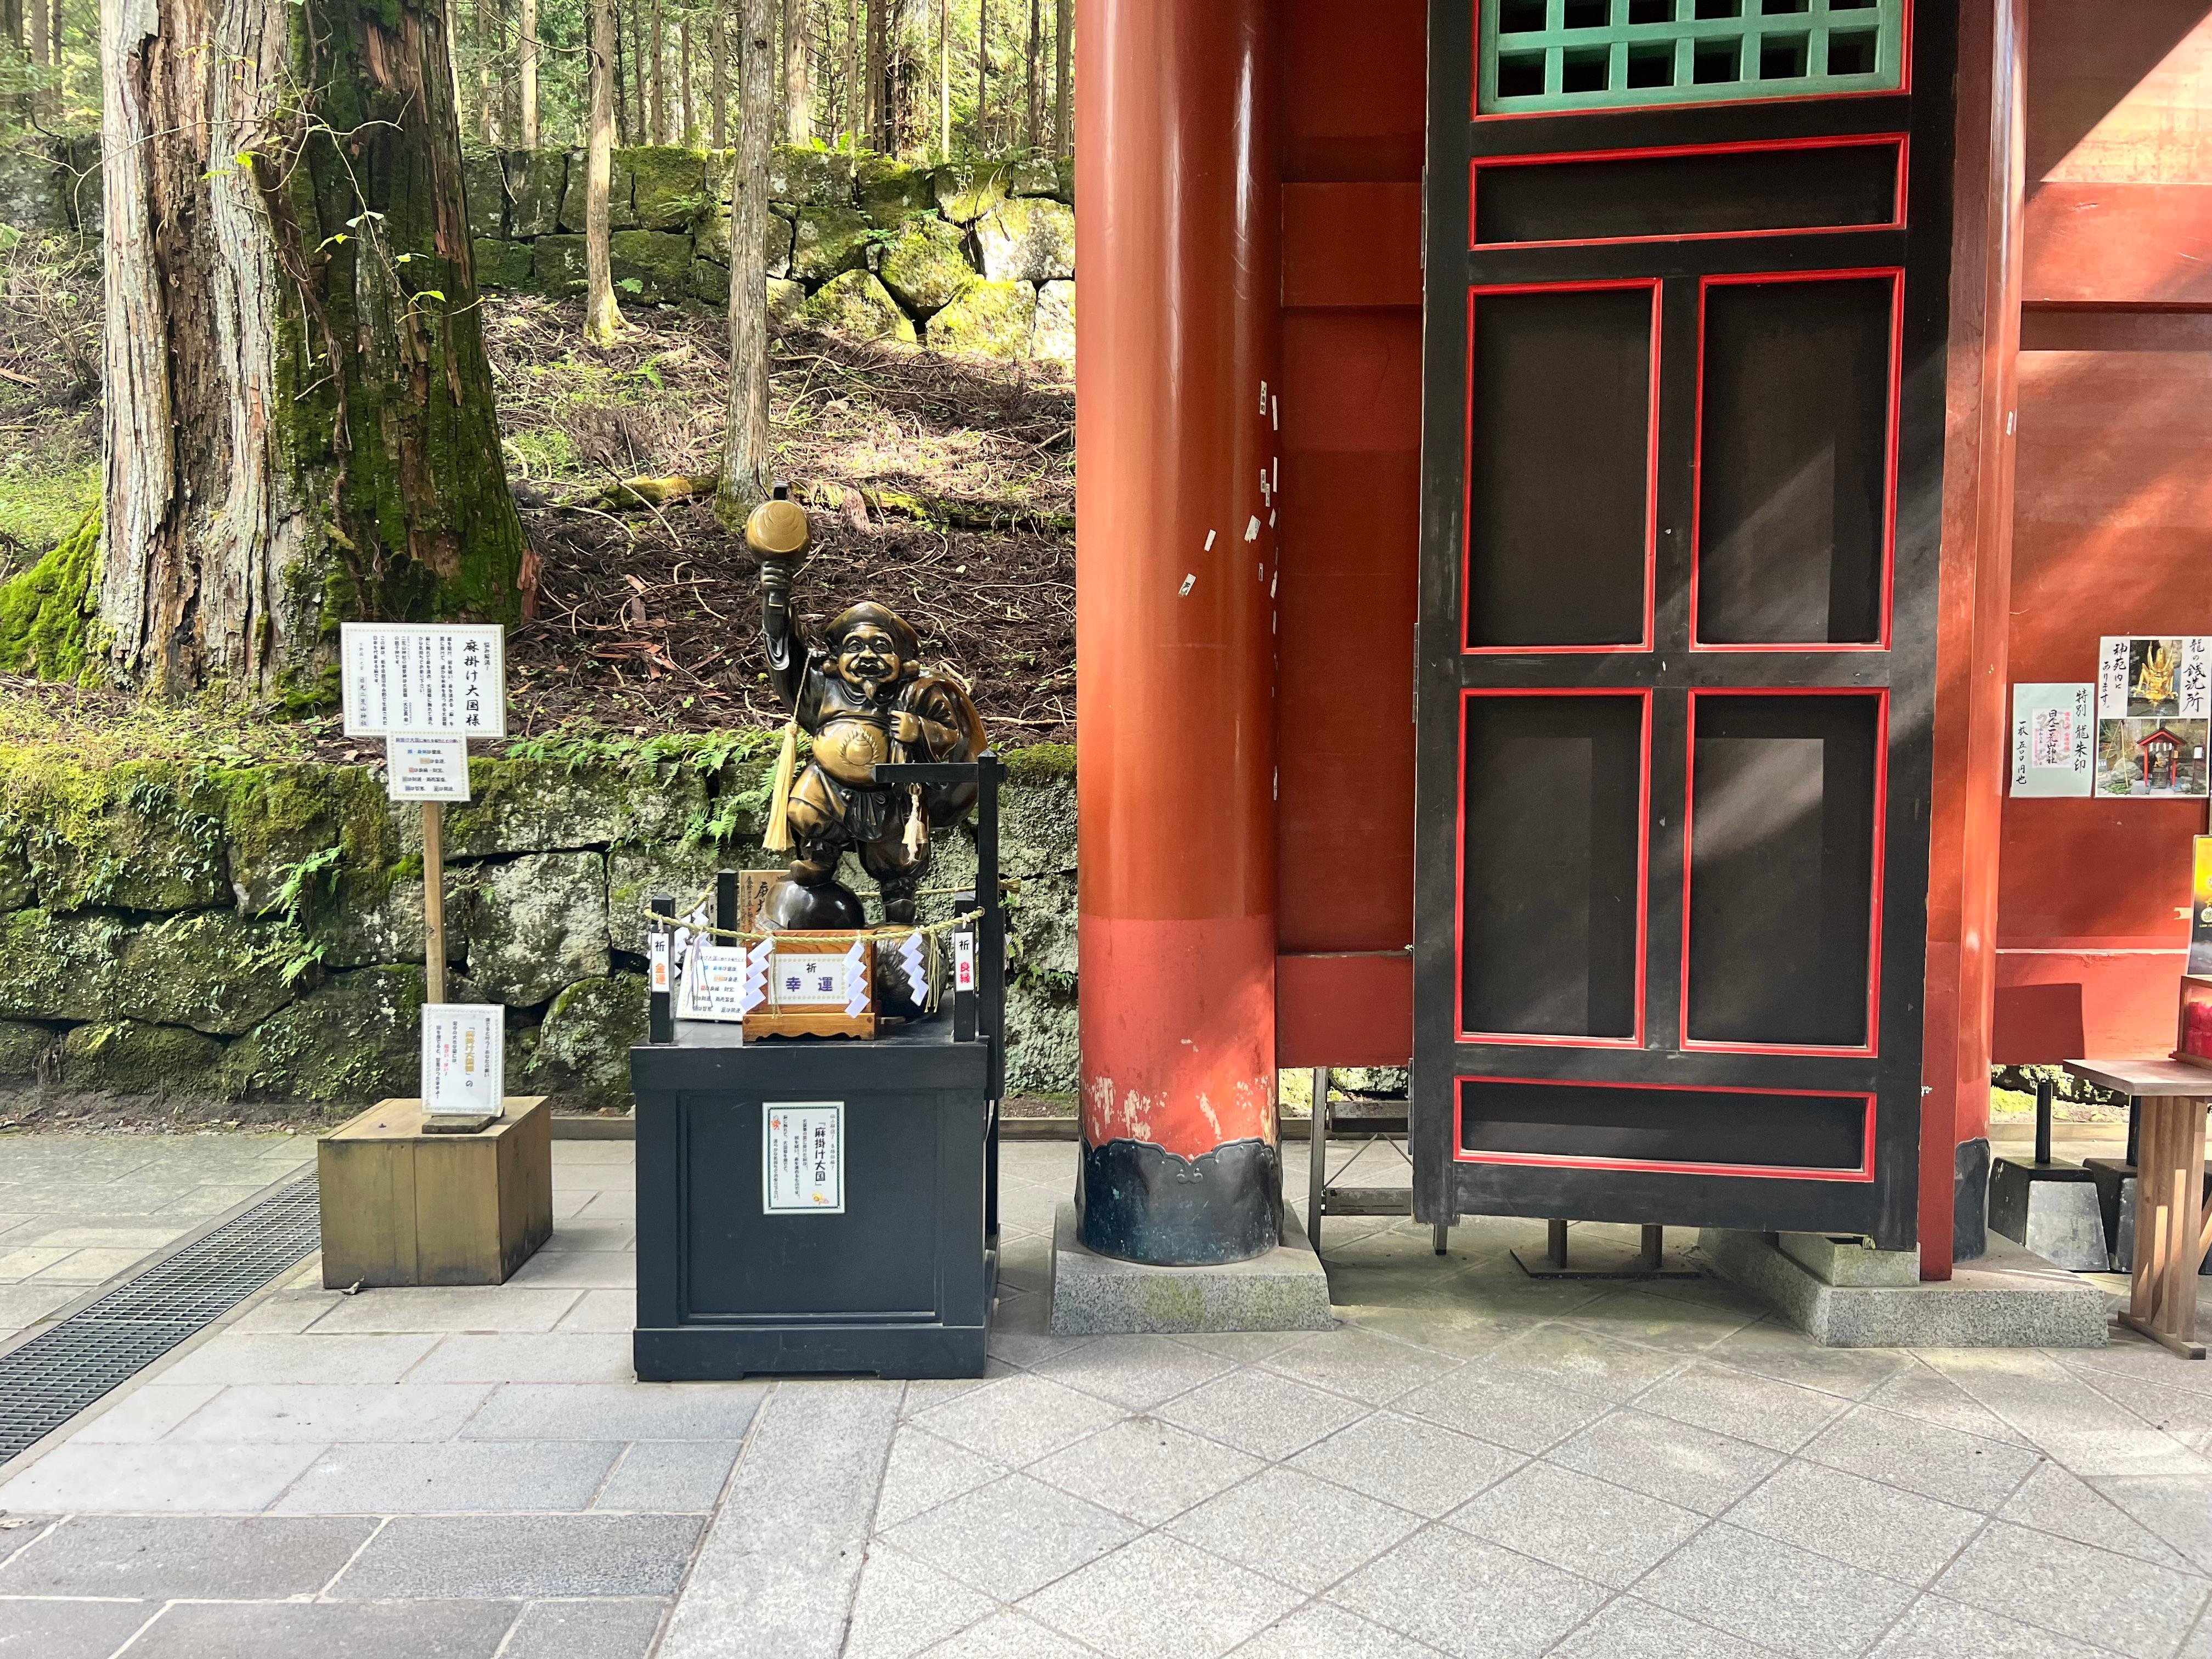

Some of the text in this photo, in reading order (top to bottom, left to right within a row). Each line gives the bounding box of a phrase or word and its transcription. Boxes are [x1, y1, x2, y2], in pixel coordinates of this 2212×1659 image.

[2113, 642, 2128, 689] 神苑内に
[2182, 639, 2207, 712] 龍の銭洗所
[463, 639, 481, 727] 麻掛け大国様
[2100, 661, 2112, 708] あります。
[2017, 721, 2029, 736] 一枚
[2073, 688, 2089, 774] 特別 龍朱印
[654, 940, 666, 952] 祈
[959, 939, 970, 950] 祈
[655, 963, 666, 985] 金運
[806, 963, 816, 973] 祈
[960, 962, 970, 983] 良縁
[786, 977, 833, 992] 幸運
